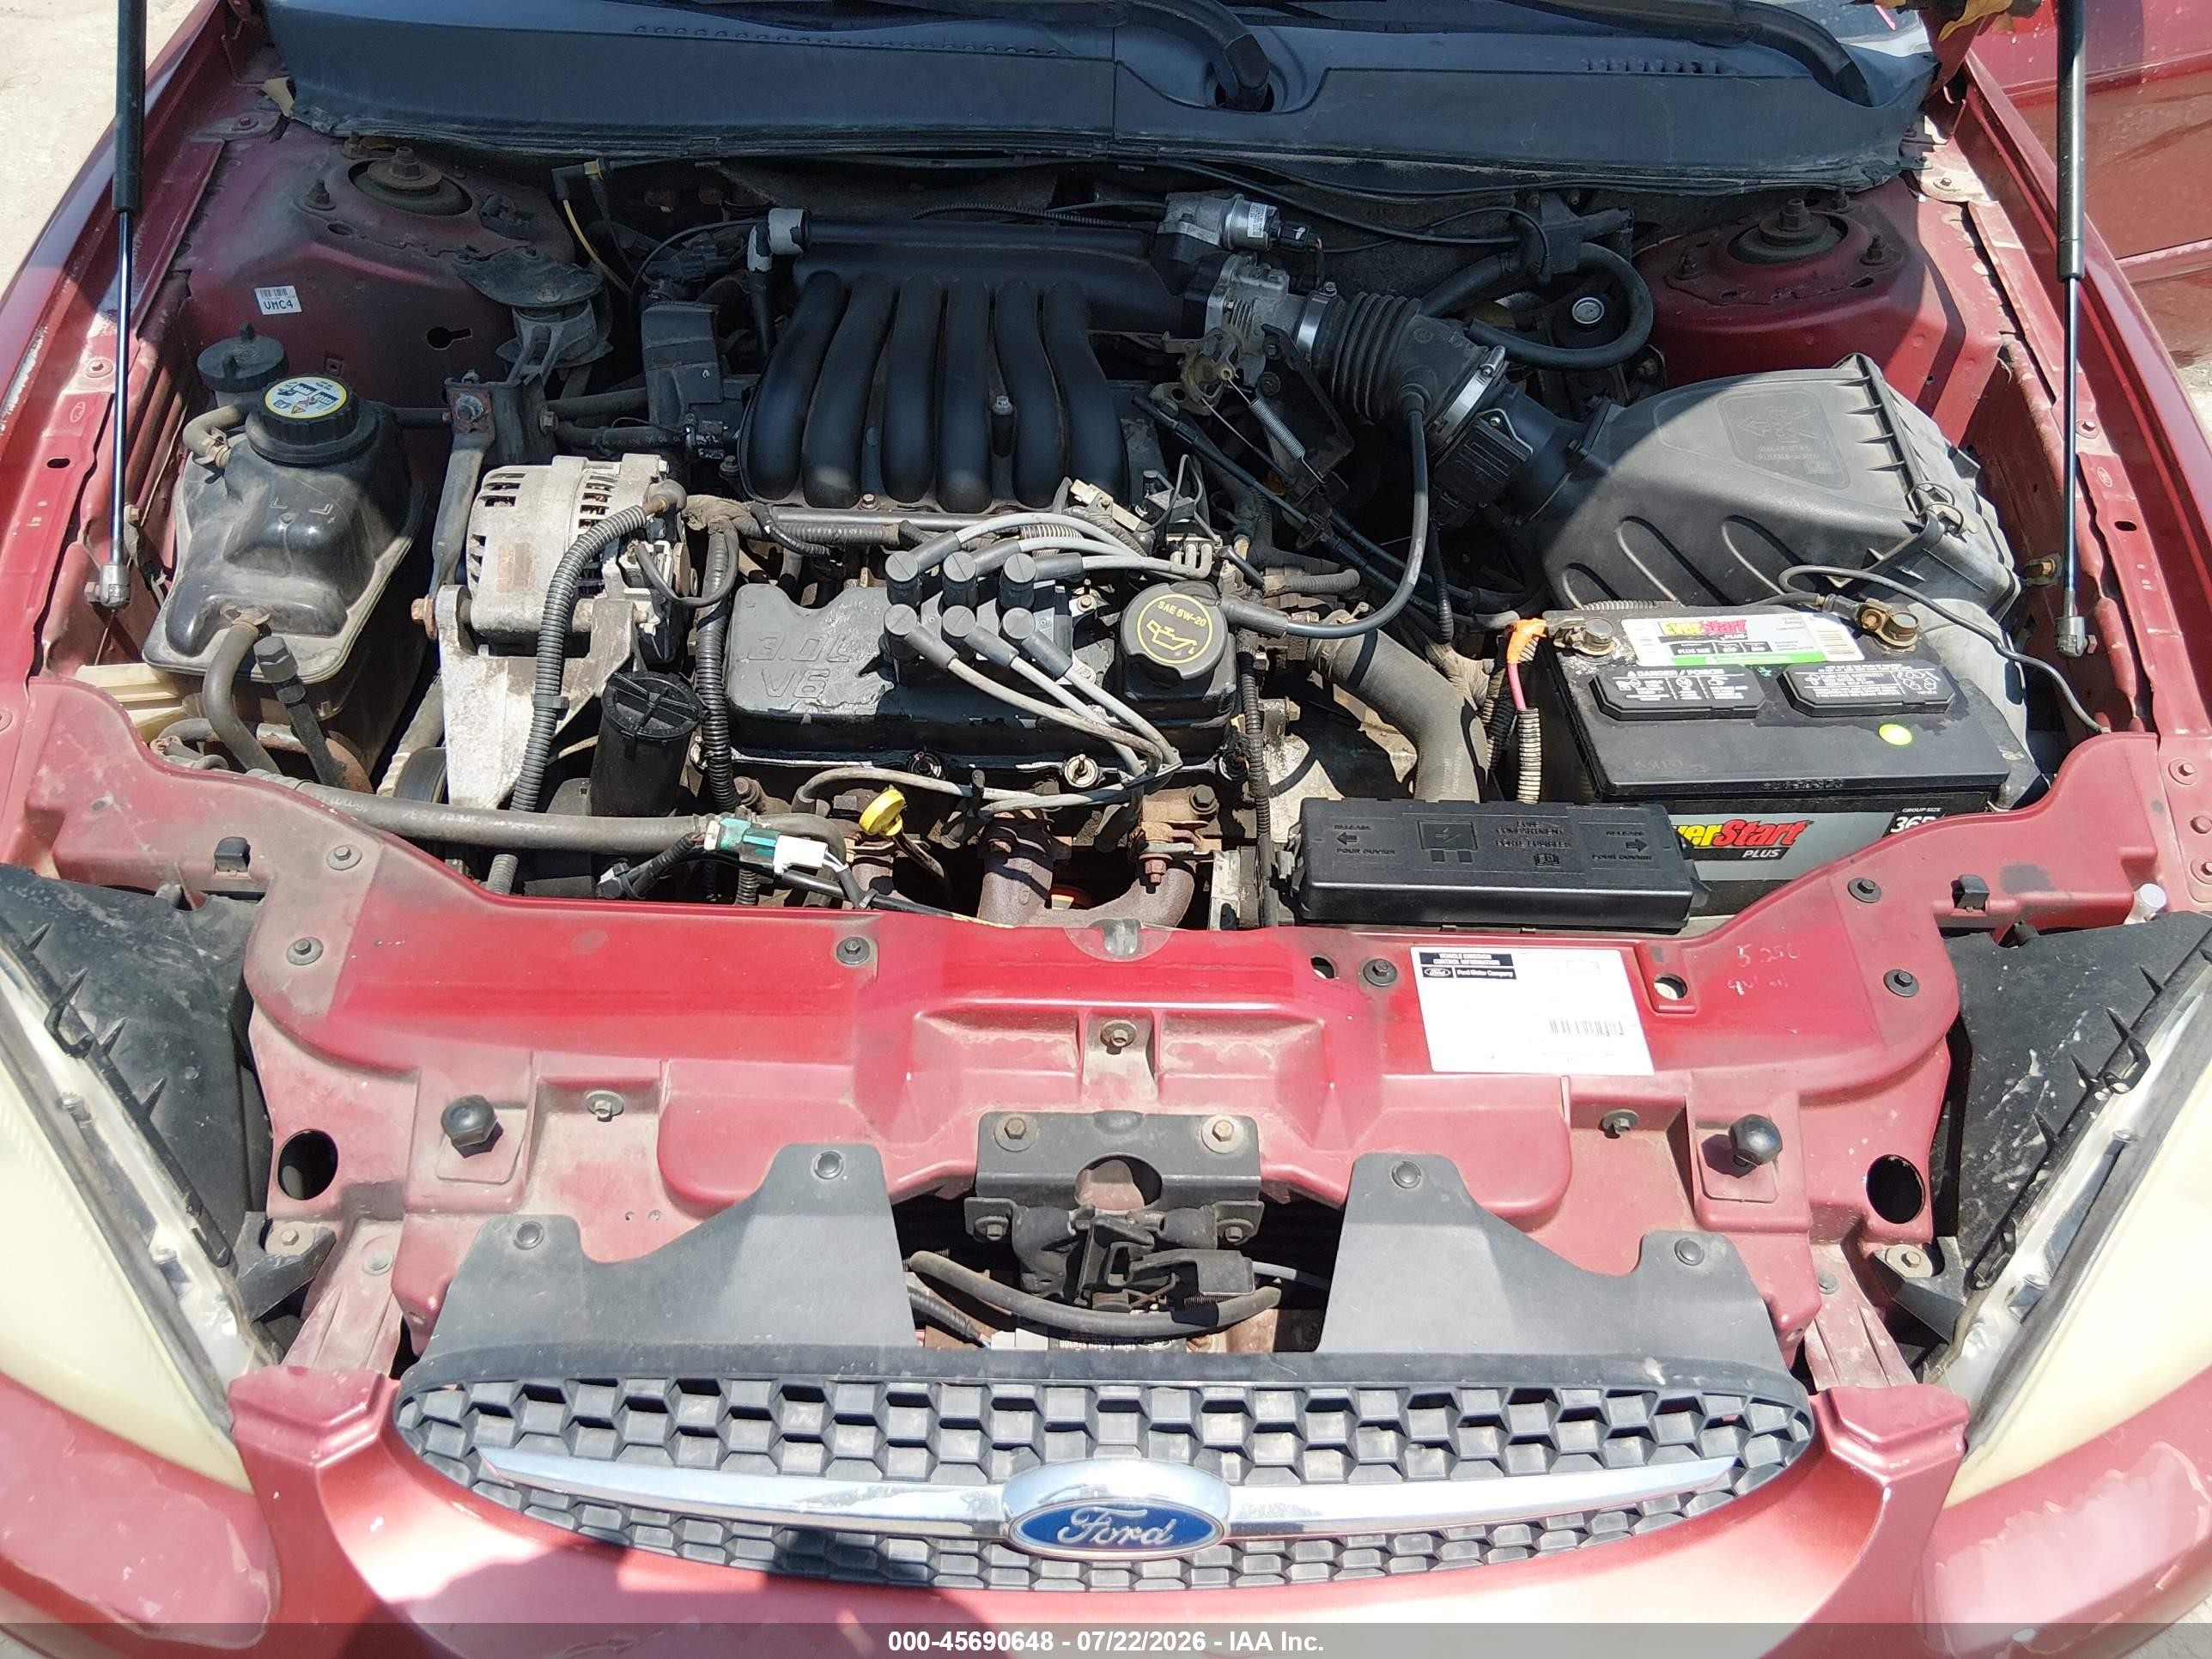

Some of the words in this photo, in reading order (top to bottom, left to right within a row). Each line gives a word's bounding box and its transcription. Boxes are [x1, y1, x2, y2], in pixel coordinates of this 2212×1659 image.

[264, 300, 294, 310] VMC4
[1158, 600, 1177, 616] SAE
[1658, 620, 1747, 636] EverStart
[761, 668, 830, 699] V6
[1741, 849, 1782, 858] PLUS
[1057, 1505, 1177, 1545] Ford
